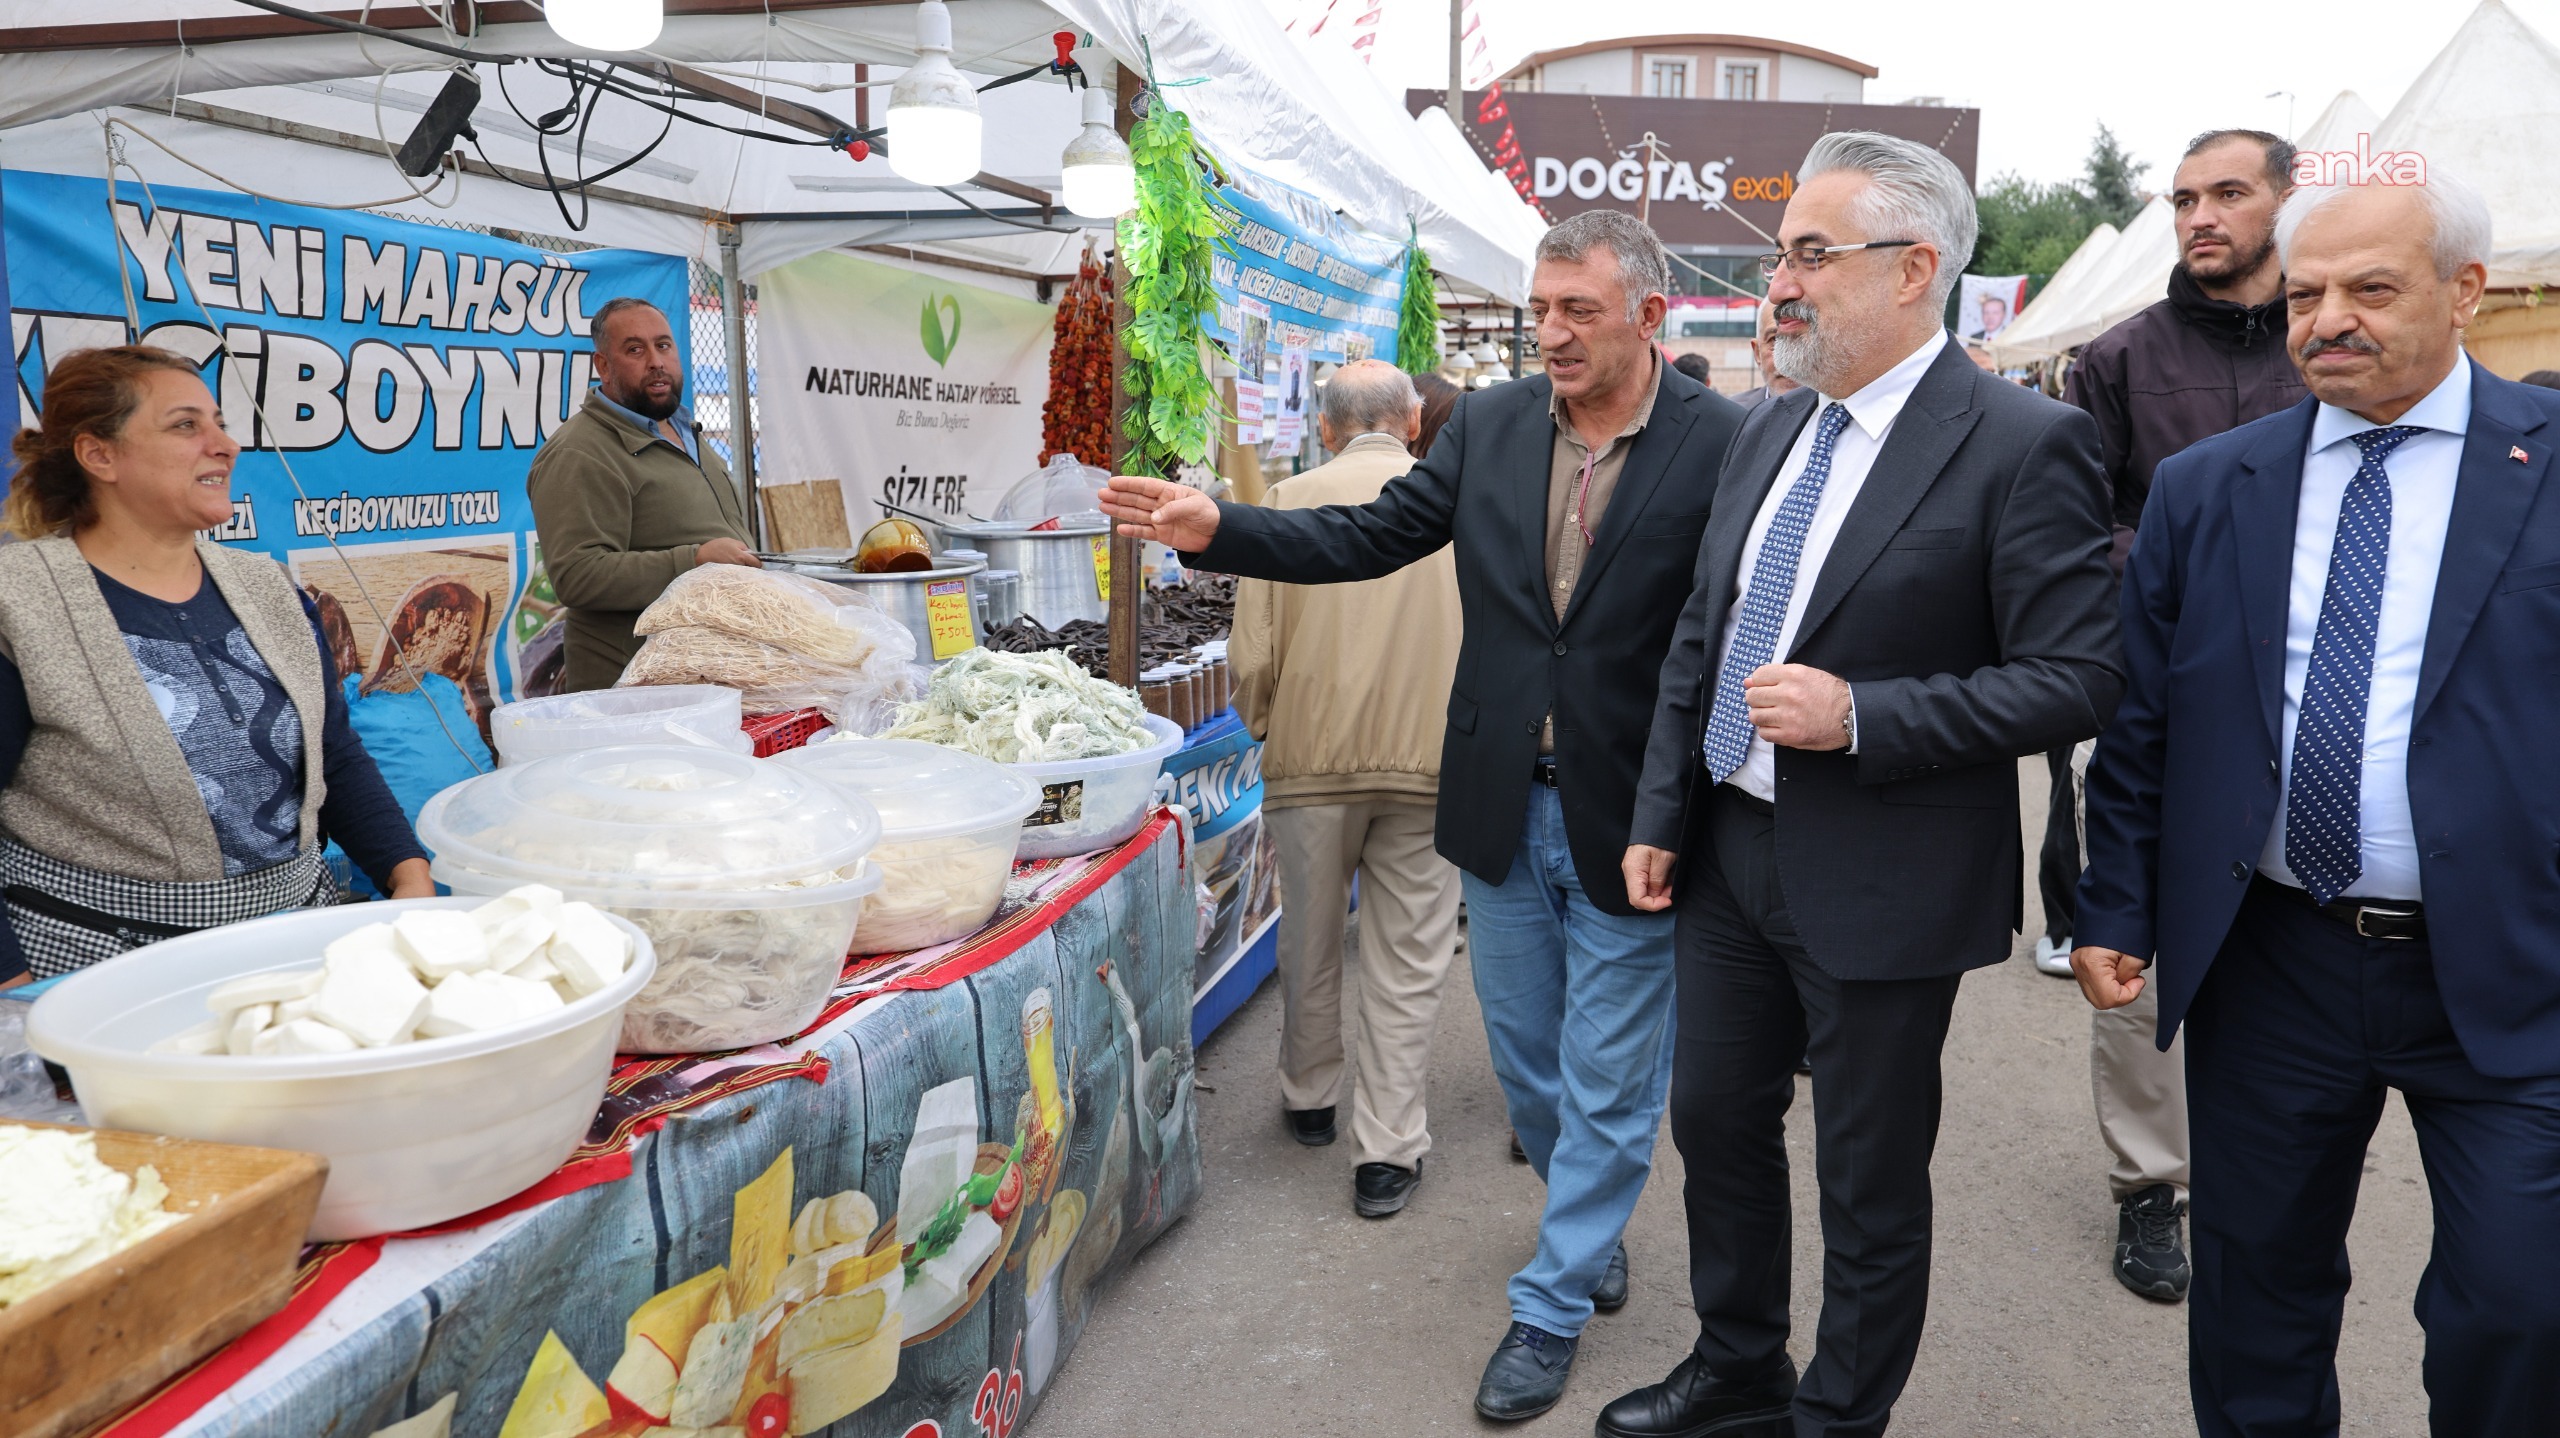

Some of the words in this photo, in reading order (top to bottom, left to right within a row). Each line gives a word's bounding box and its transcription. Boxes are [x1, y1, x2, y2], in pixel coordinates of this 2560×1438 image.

[1534, 150, 1728, 211] DOĞTAŞ
[107, 198, 326, 321] YENİ
[341, 235, 592, 338] MAHSÜL
[804, 366, 933, 401] NATURHANE
[936, 382, 978, 404] HATAY
[979, 382, 1022, 405] YÖRESEL
[896, 409, 912, 427] Biz
[914, 411, 938, 428] Buna
[294, 491, 447, 540] KEÇİBOYNUZU
[449, 490, 501, 526] TOZU
